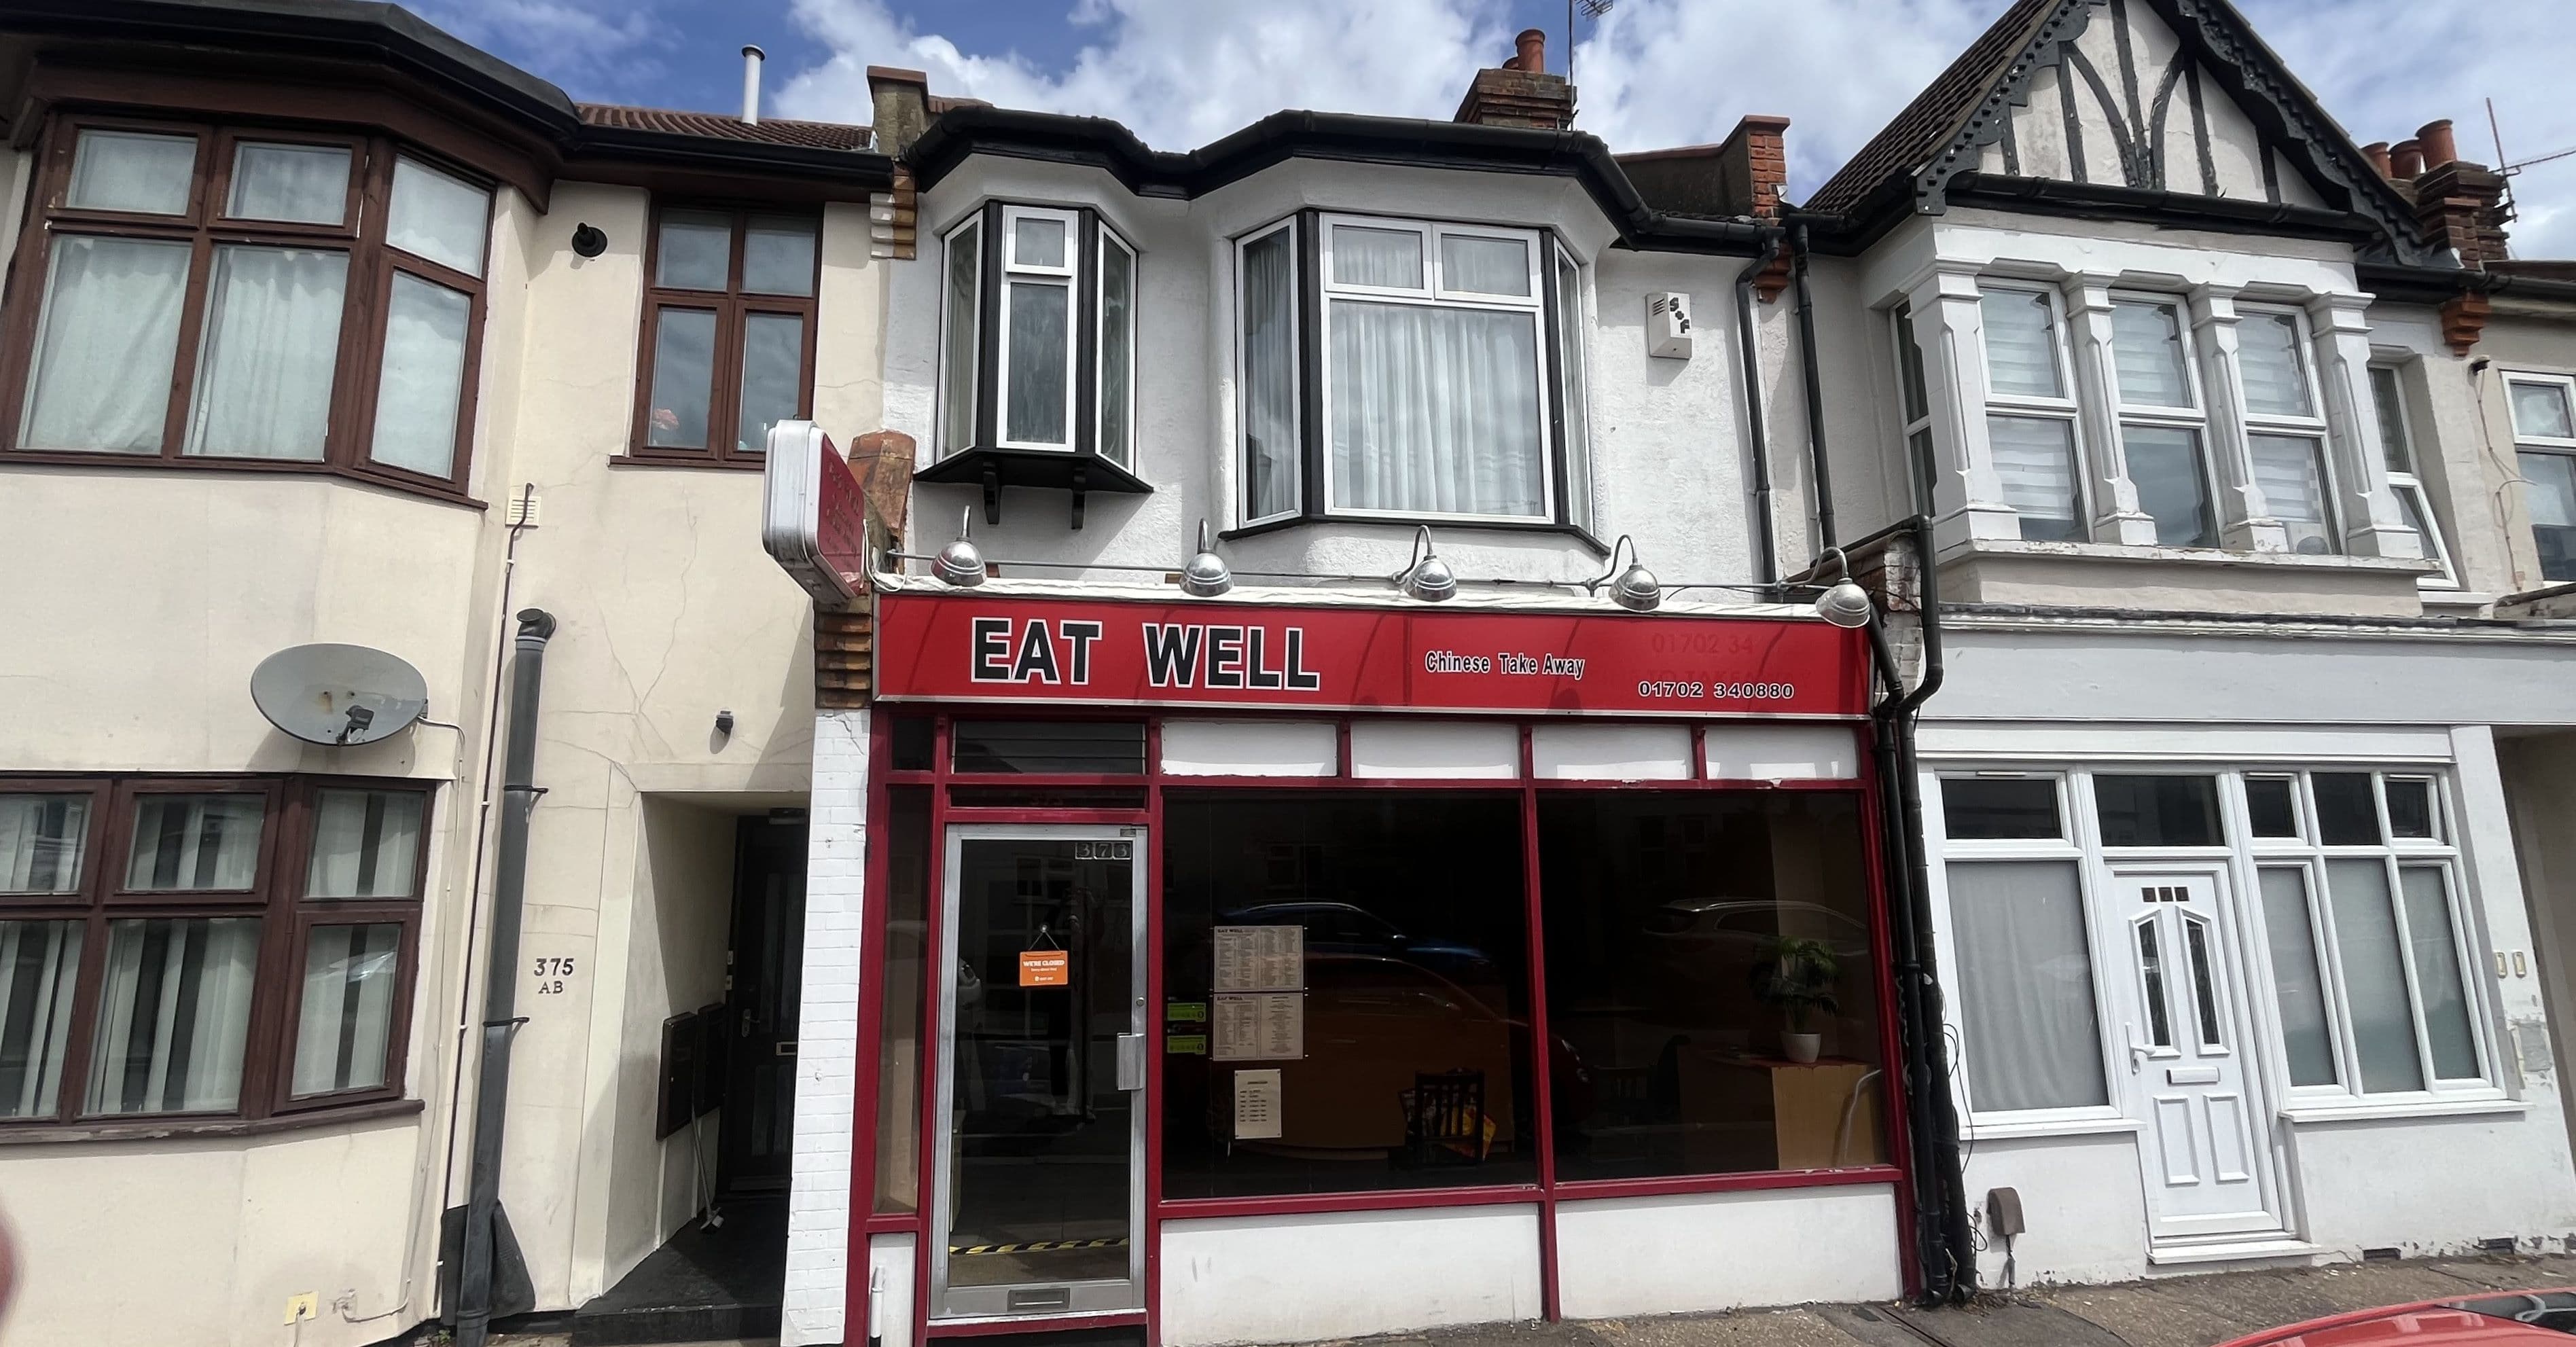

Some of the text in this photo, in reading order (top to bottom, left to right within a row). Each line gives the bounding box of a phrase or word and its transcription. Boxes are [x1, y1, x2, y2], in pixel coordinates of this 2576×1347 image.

[1651, 632, 1720, 654] 01702
[970, 616, 1321, 692] EAT WELL
[1425, 649, 1586, 681] Chinese Take Away
[1638, 681, 1795, 699] 01702 340880
[1077, 843, 1128, 857] 373
[533, 958, 574, 976] 375
[538, 980, 563, 994] AB
